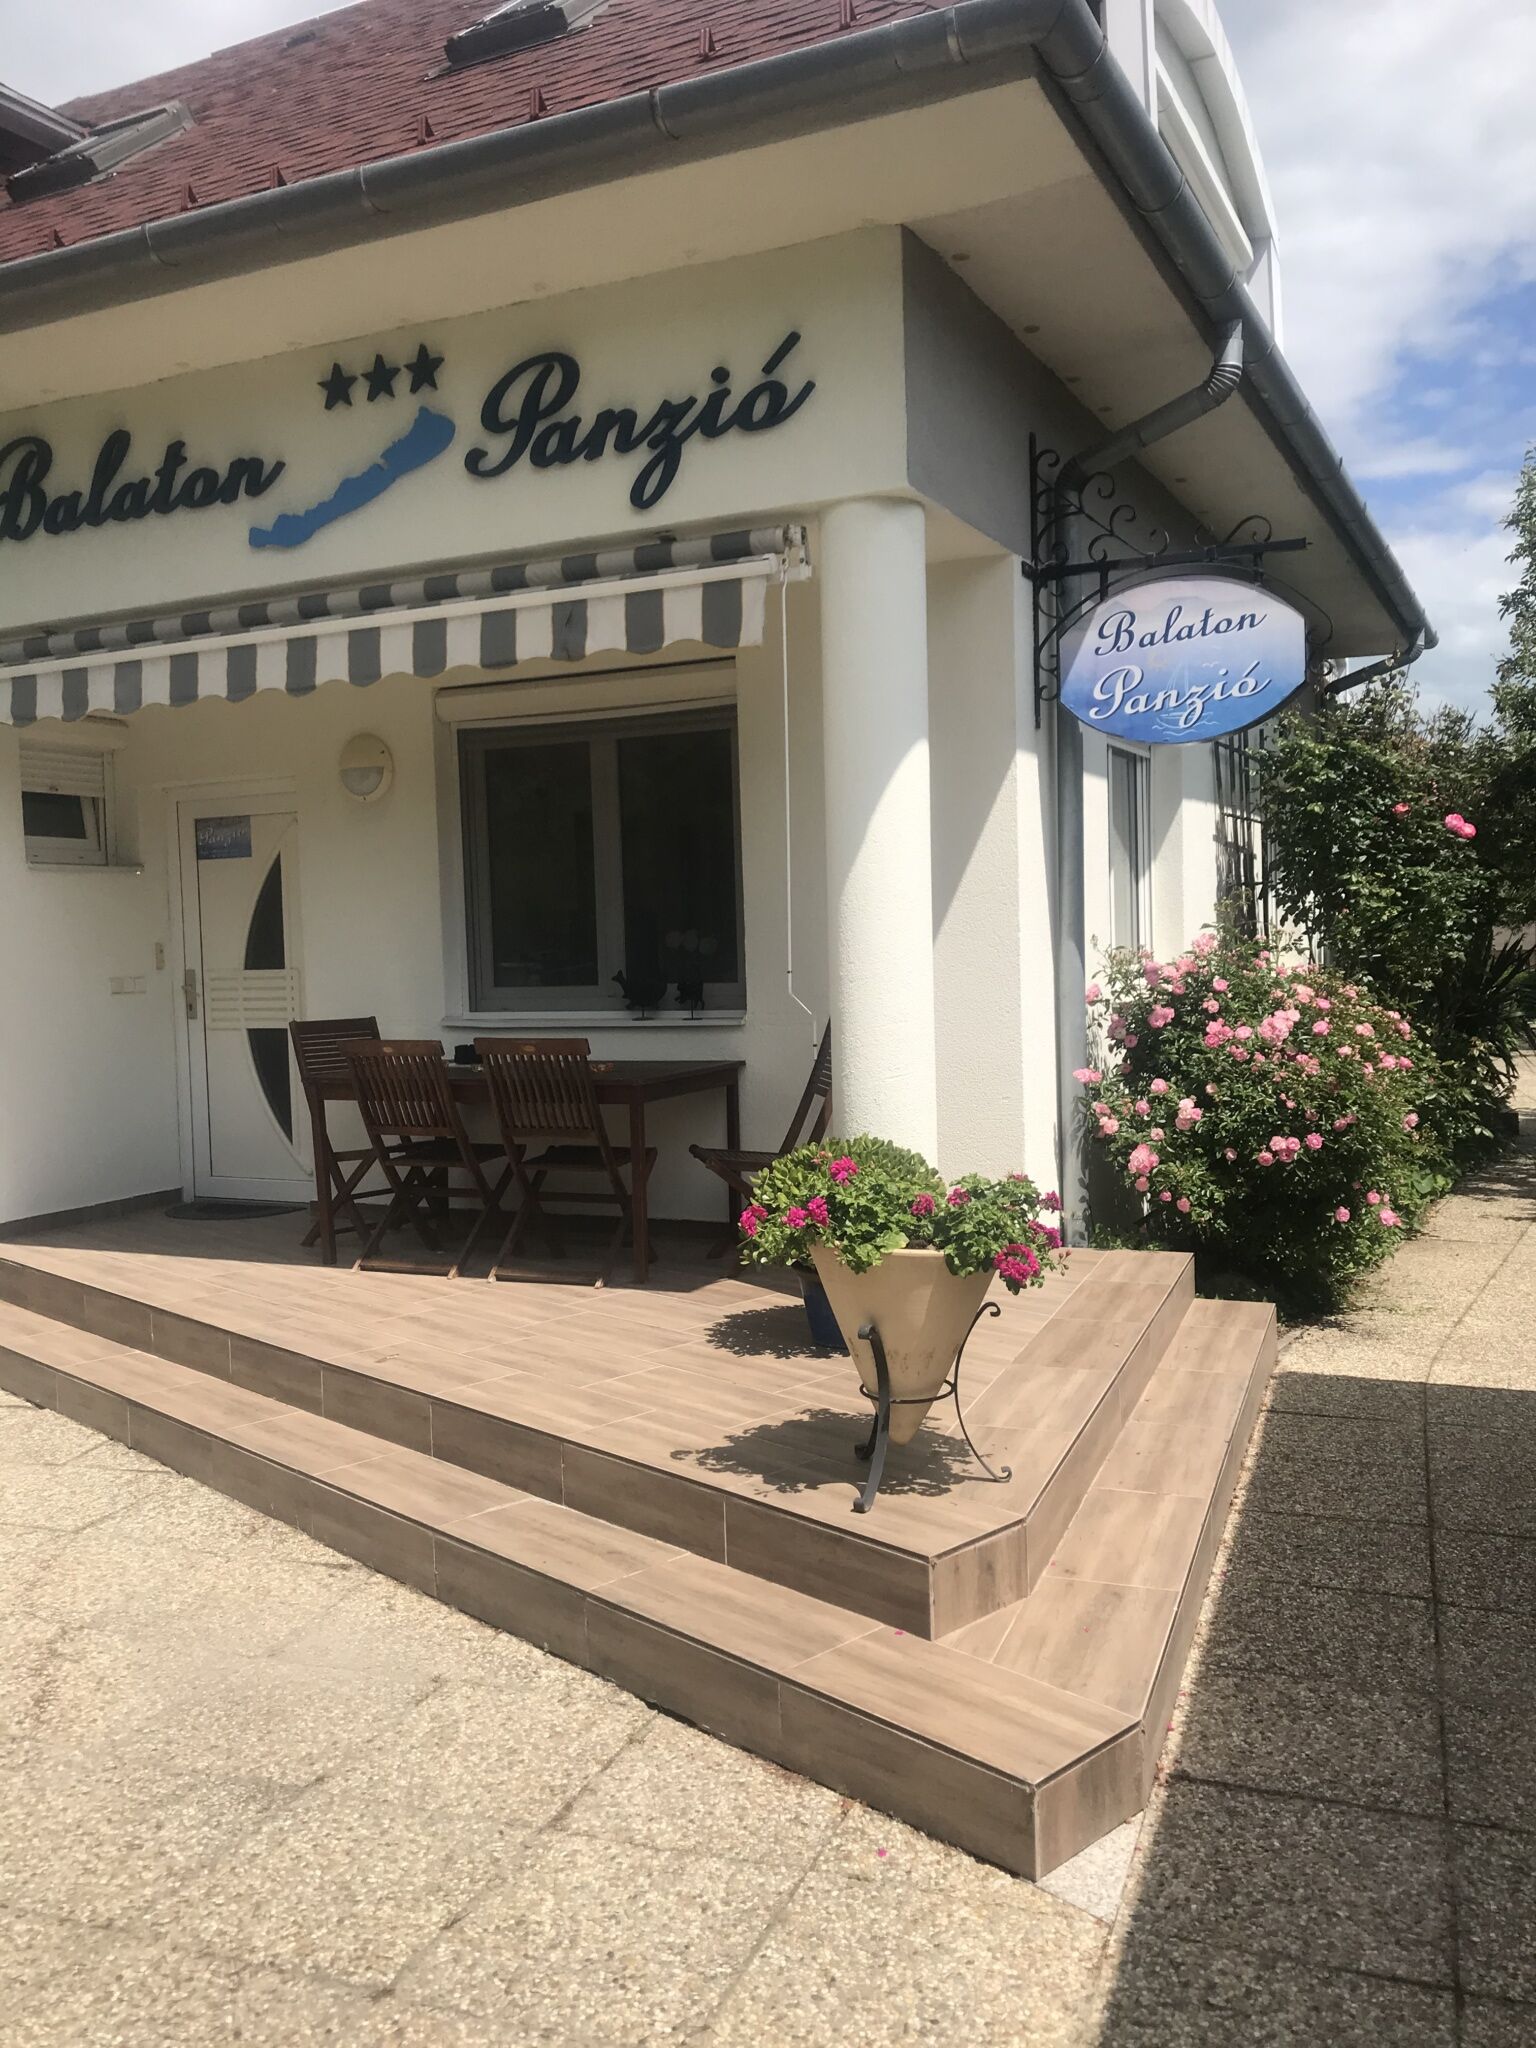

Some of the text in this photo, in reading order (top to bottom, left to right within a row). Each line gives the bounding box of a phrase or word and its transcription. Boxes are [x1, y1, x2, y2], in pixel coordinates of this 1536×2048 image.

[0, 331, 816, 541] Balaton Panzió
[1094, 605, 1267, 656] Balaton
[1088, 661, 1271, 730] Panzió
